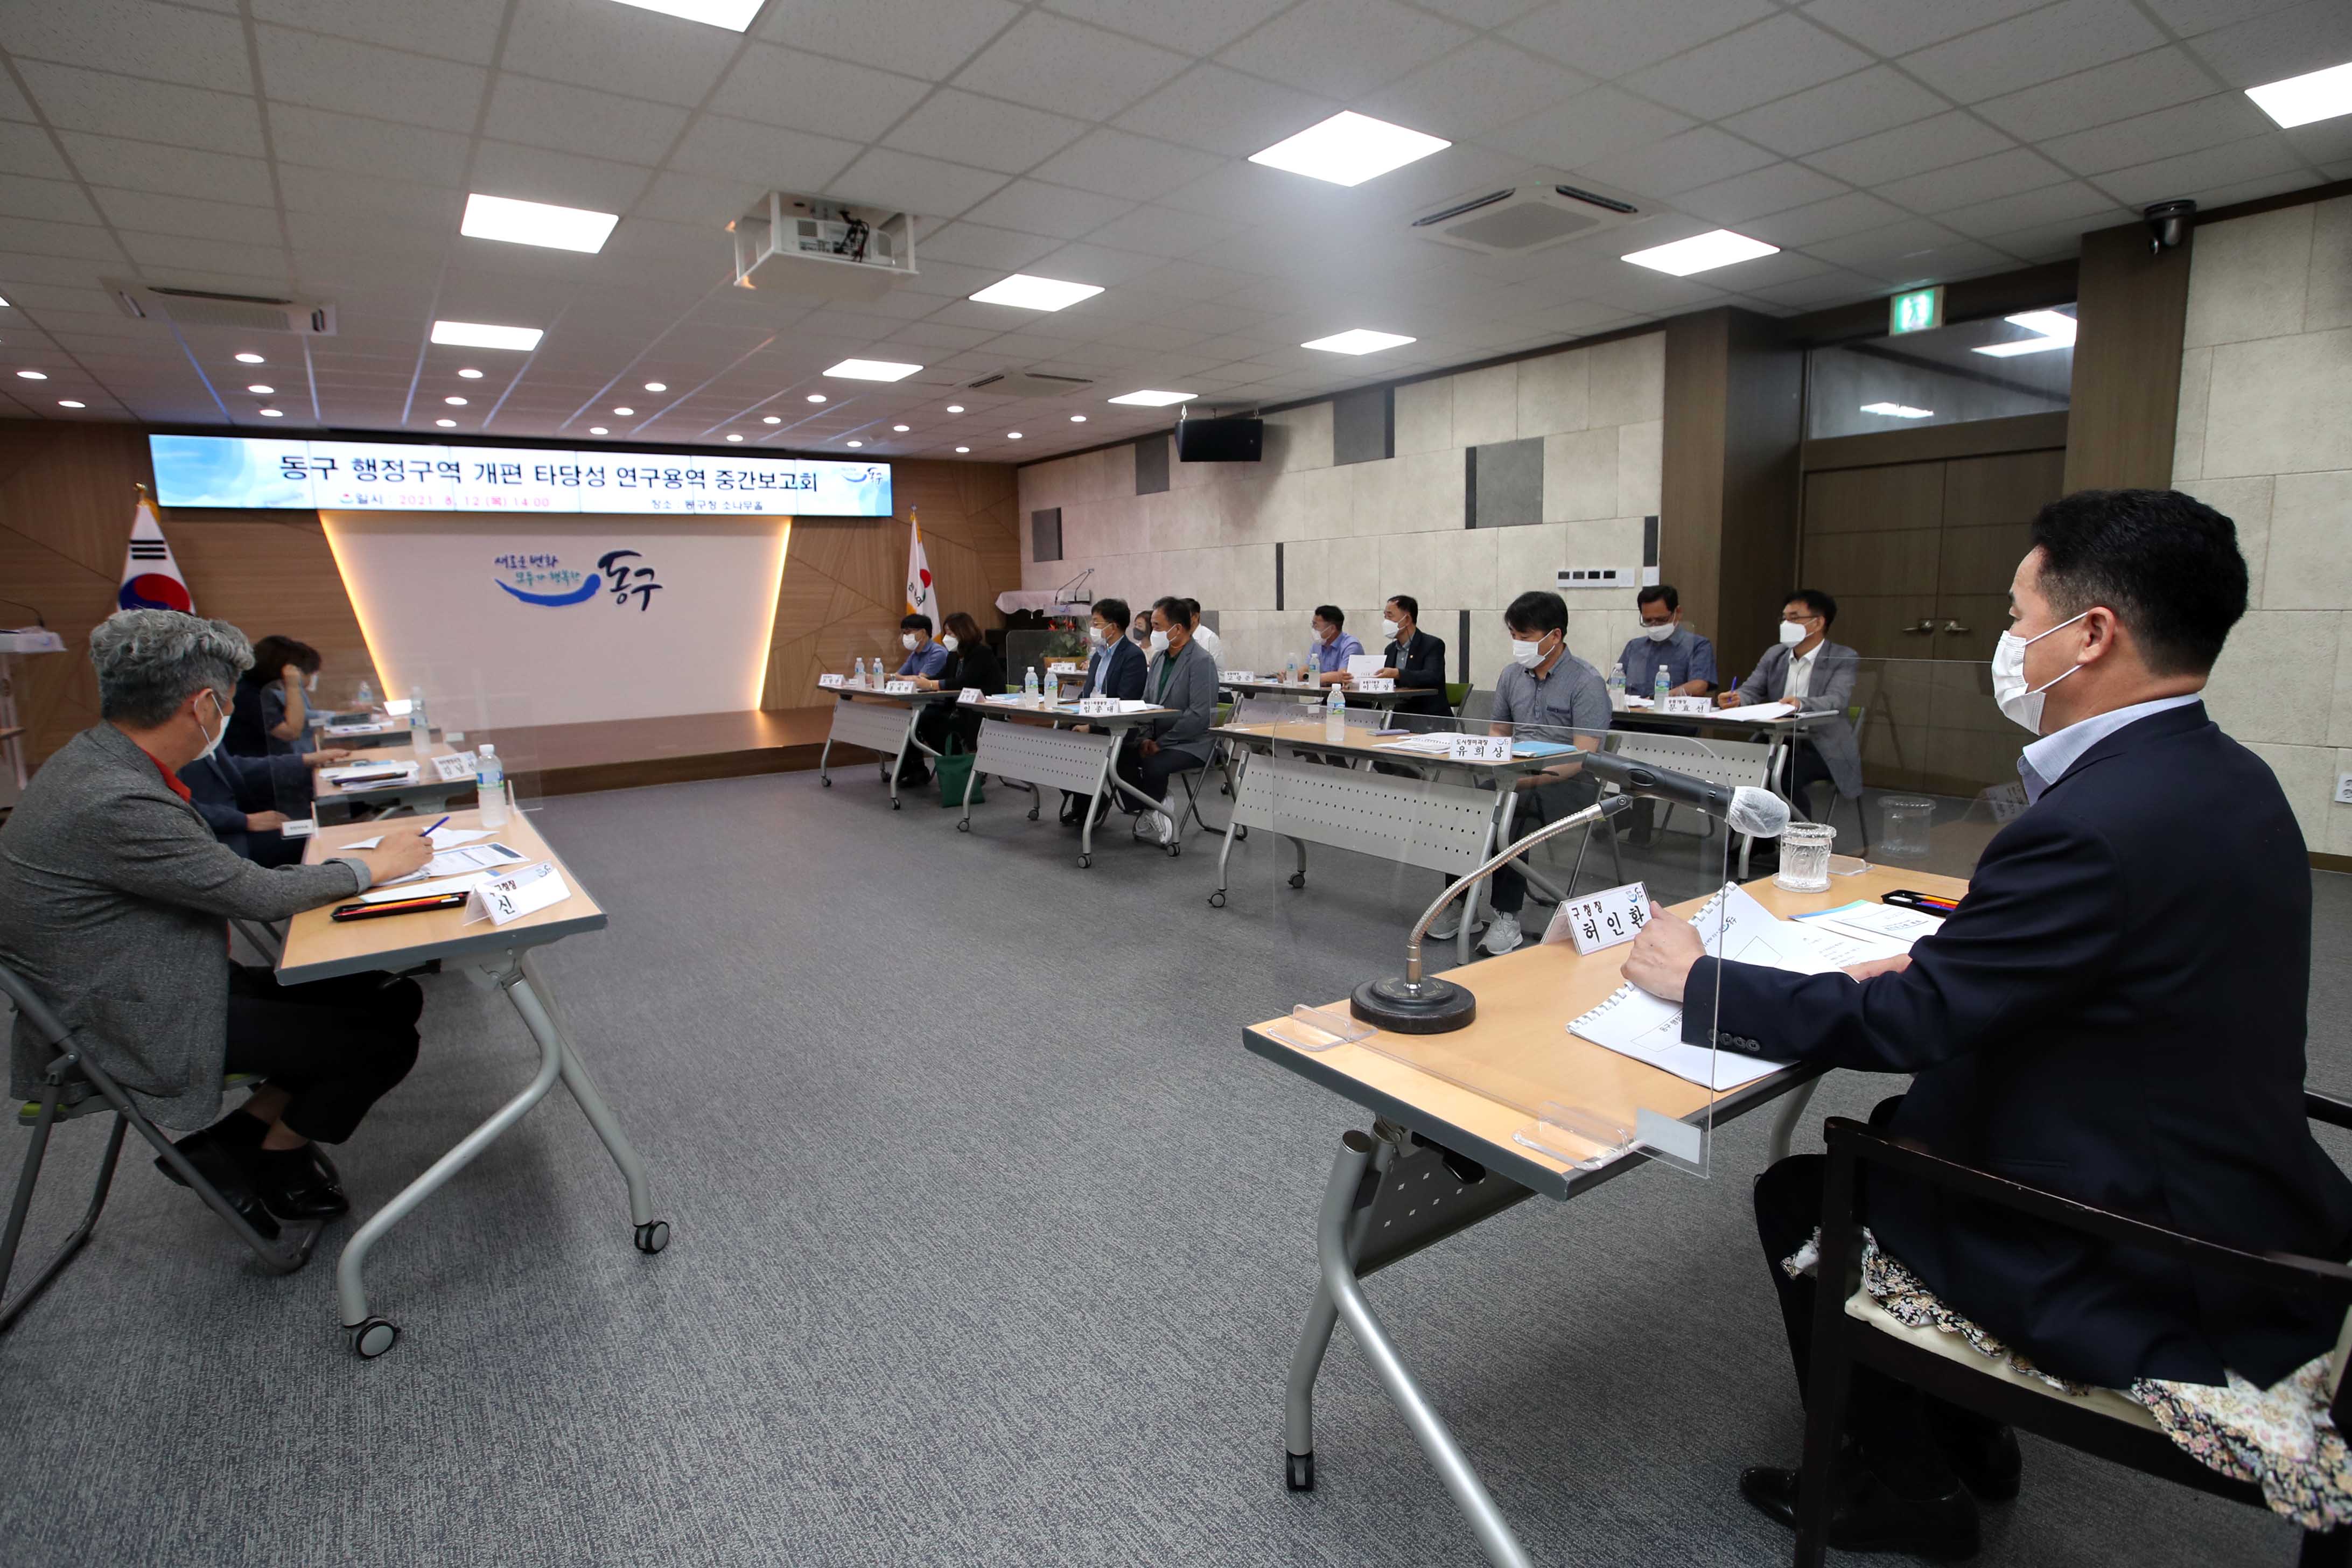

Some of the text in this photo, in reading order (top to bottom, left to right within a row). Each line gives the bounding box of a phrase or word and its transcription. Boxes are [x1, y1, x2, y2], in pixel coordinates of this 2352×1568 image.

[279, 455, 818, 492] 동구 행정구역 개편 타당성 연구용역 중간보고회
[494, 554, 558, 569] 새로운 변화
[515, 569, 581, 587] 모두가 행복한
[597, 550, 663, 612] 동구
[1455, 745, 1504, 758] 유희상
[1571, 901, 1603, 920] 구청장
[1583, 905, 1644, 943] 허인환
